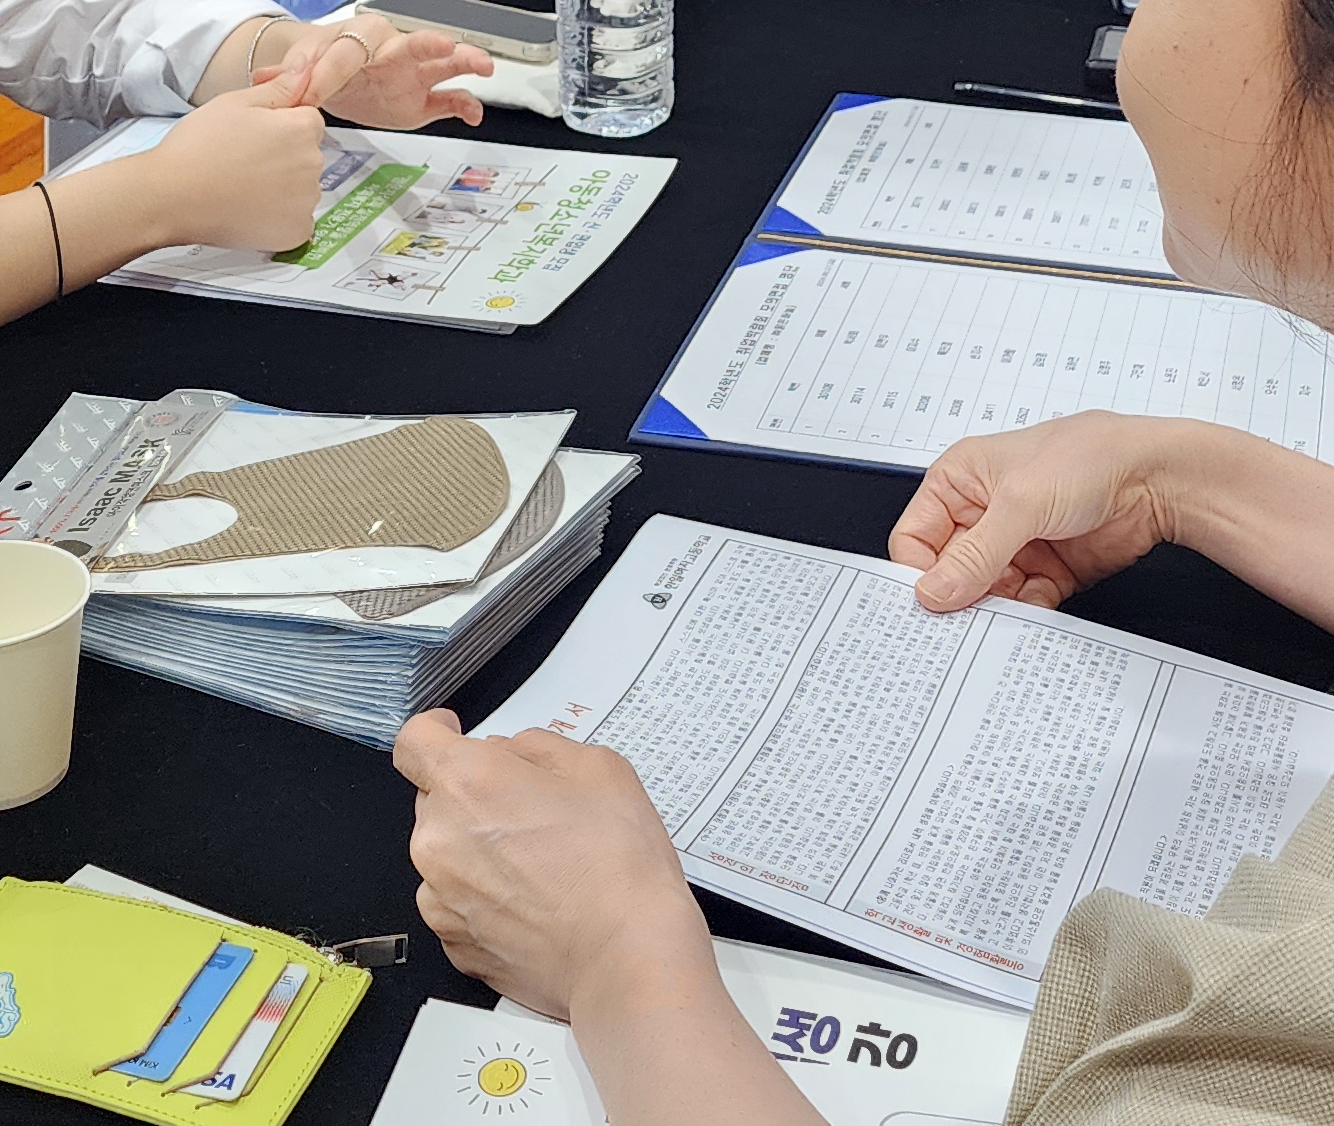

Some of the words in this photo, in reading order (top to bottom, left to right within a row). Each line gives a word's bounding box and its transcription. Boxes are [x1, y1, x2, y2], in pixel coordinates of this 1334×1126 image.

[591, 172, 638, 219] 2024학년도
[489, 169, 610, 282] 아동청소년복지학과
[706, 360, 747, 409] 2024학년도
[735, 315, 769, 354] 취업박람회
[759, 283, 787, 312] 모의면접
[67, 485, 122, 538] Isaac
[847, 1021, 918, 1070] 강
[201, 1071, 236, 1091] SA
